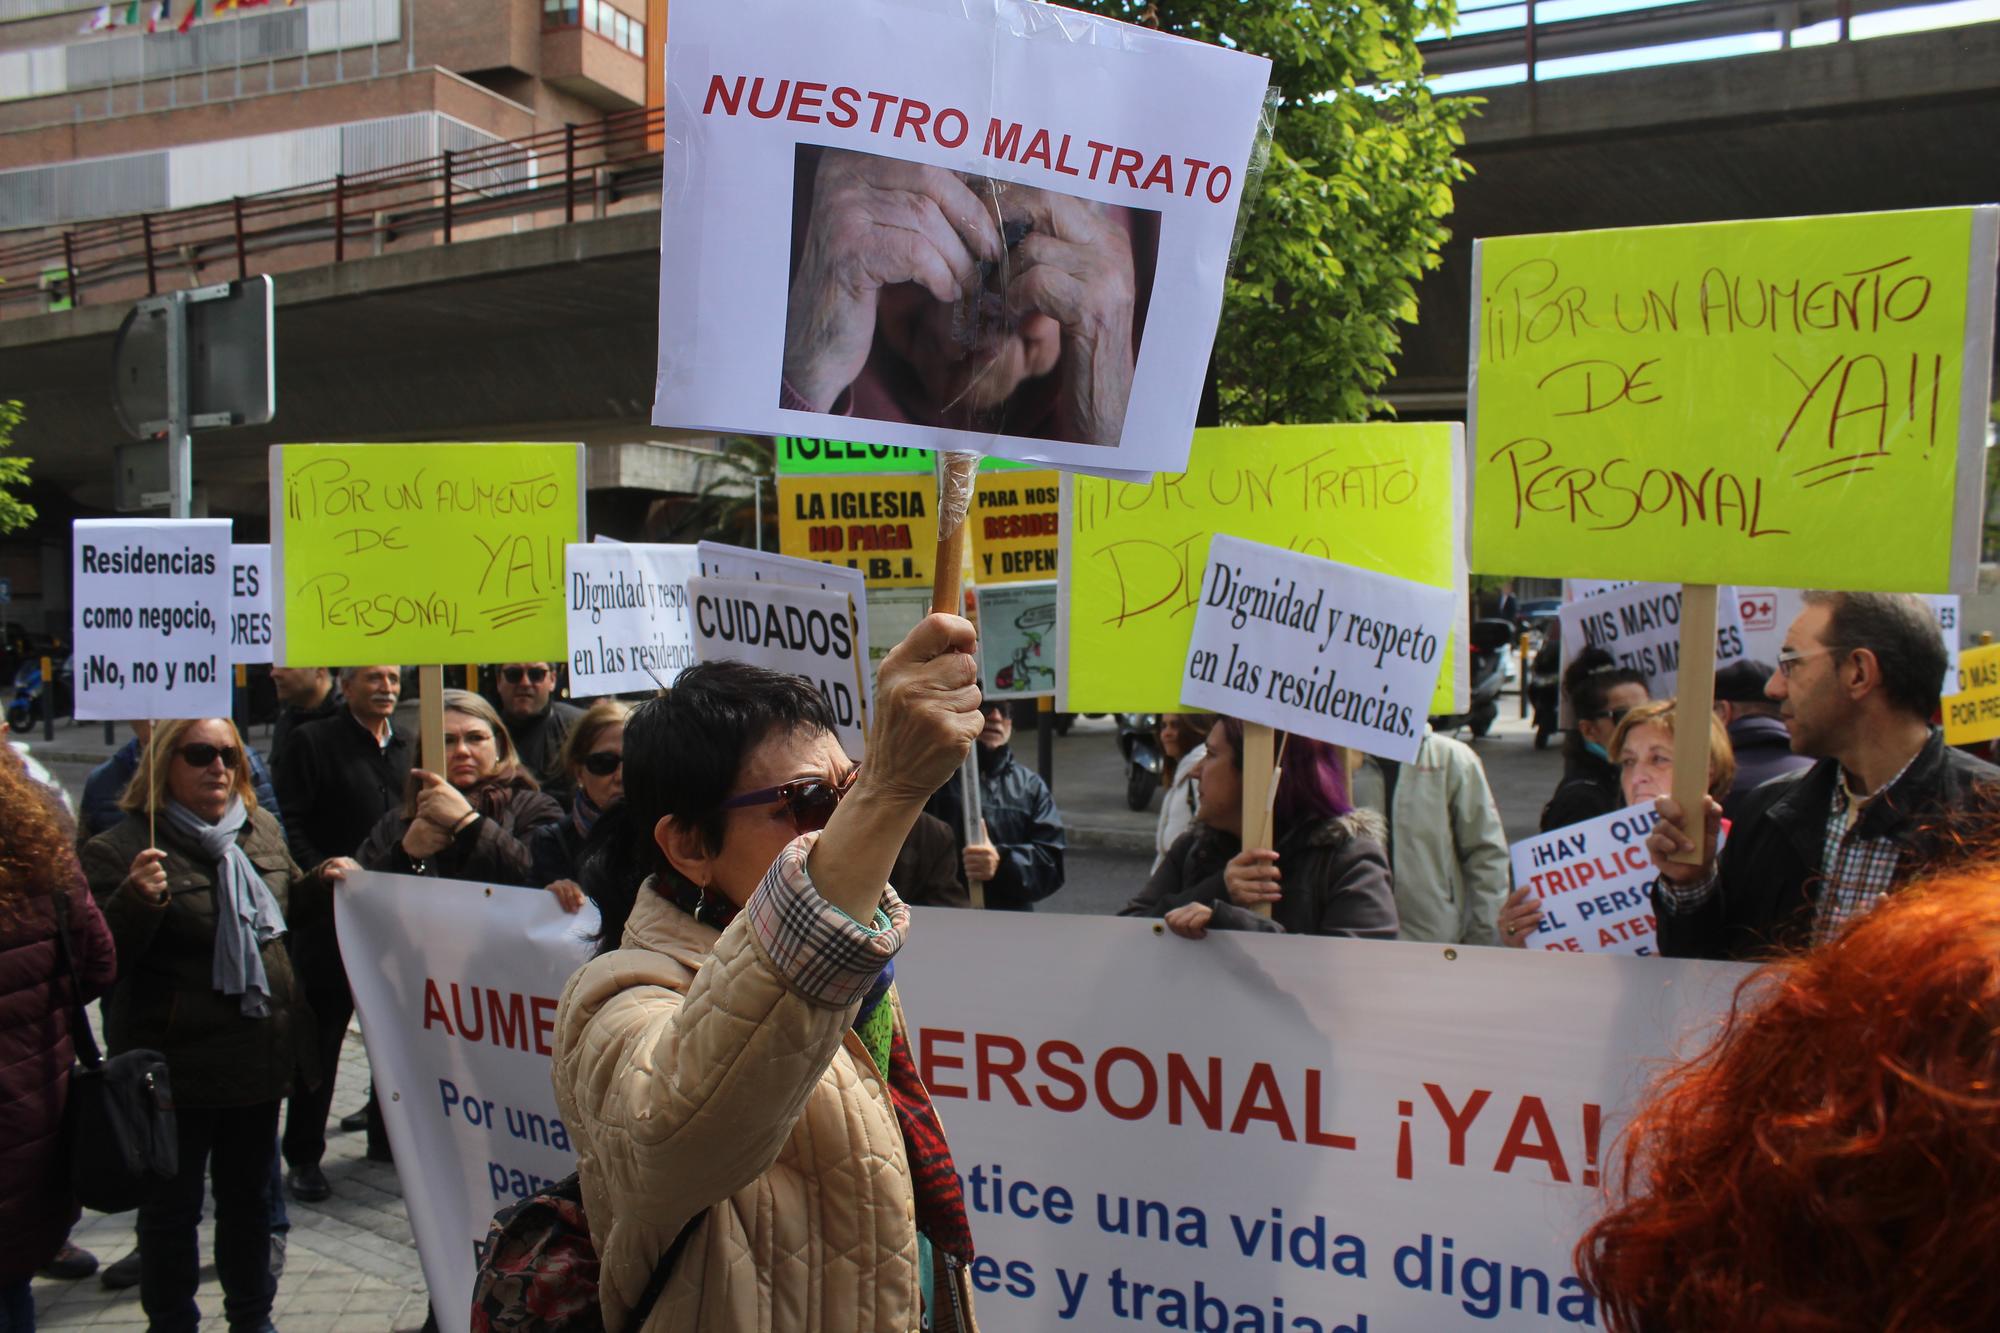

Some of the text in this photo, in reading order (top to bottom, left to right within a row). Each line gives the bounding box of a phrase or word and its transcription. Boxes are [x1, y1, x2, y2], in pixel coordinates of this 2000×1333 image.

[702, 75, 1232, 204] NUESTRO MALTRATO
[1615, 280, 1679, 333] UN
[1701, 256, 1931, 335] AUMENTO
[1537, 358, 1663, 417] DE
[1772, 352, 1941, 461] YA!!
[384, 467, 426, 511] UN
[437, 473, 558, 518] AUMENTO
[796, 491, 925, 520] LA IGLESIA
[978, 487, 1059, 508] PARA HOS
[1209, 463, 1277, 512] UN
[1284, 449, 1419, 512] TRATO
[1490, 438, 1790, 537] PERSONAL
[334, 527, 408, 555] DE
[809, 524, 913, 553] NO PAGA
[983, 512, 1059, 540] RESIDE
[82, 545, 216, 575] Residencias
[473, 534, 566, 597] YA!!
[982, 548, 1059, 575] Y DEPEN
[83, 601, 216, 636] como negocio,
[297, 573, 474, 636] PERSONAL
[572, 570, 688, 624] Dignidad y resp
[1206, 563, 1437, 669] Dignidad y respeto
[1580, 591, 1682, 647] MIS MAYO
[696, 595, 852, 660] CUIDADOS
[83, 654, 216, 691] ¡No, no y no!
[574, 651, 594, 675] en
[598, 636, 625, 674] las
[1621, 647, 1657, 676] TUS
[1190, 643, 1415, 738] en las residencias.
[1530, 846, 1648, 898] TRIPLIC
[1532, 833, 1586, 867] ¡HAY
[424, 978, 559, 1056] AUME
[439, 1079, 571, 1151] Por una
[919, 1027, 1600, 1187] ERSONAL ¡YA!
[960, 1164, 1597, 1326] tice una vida digna
[1056, 1268, 1088, 1319] y
